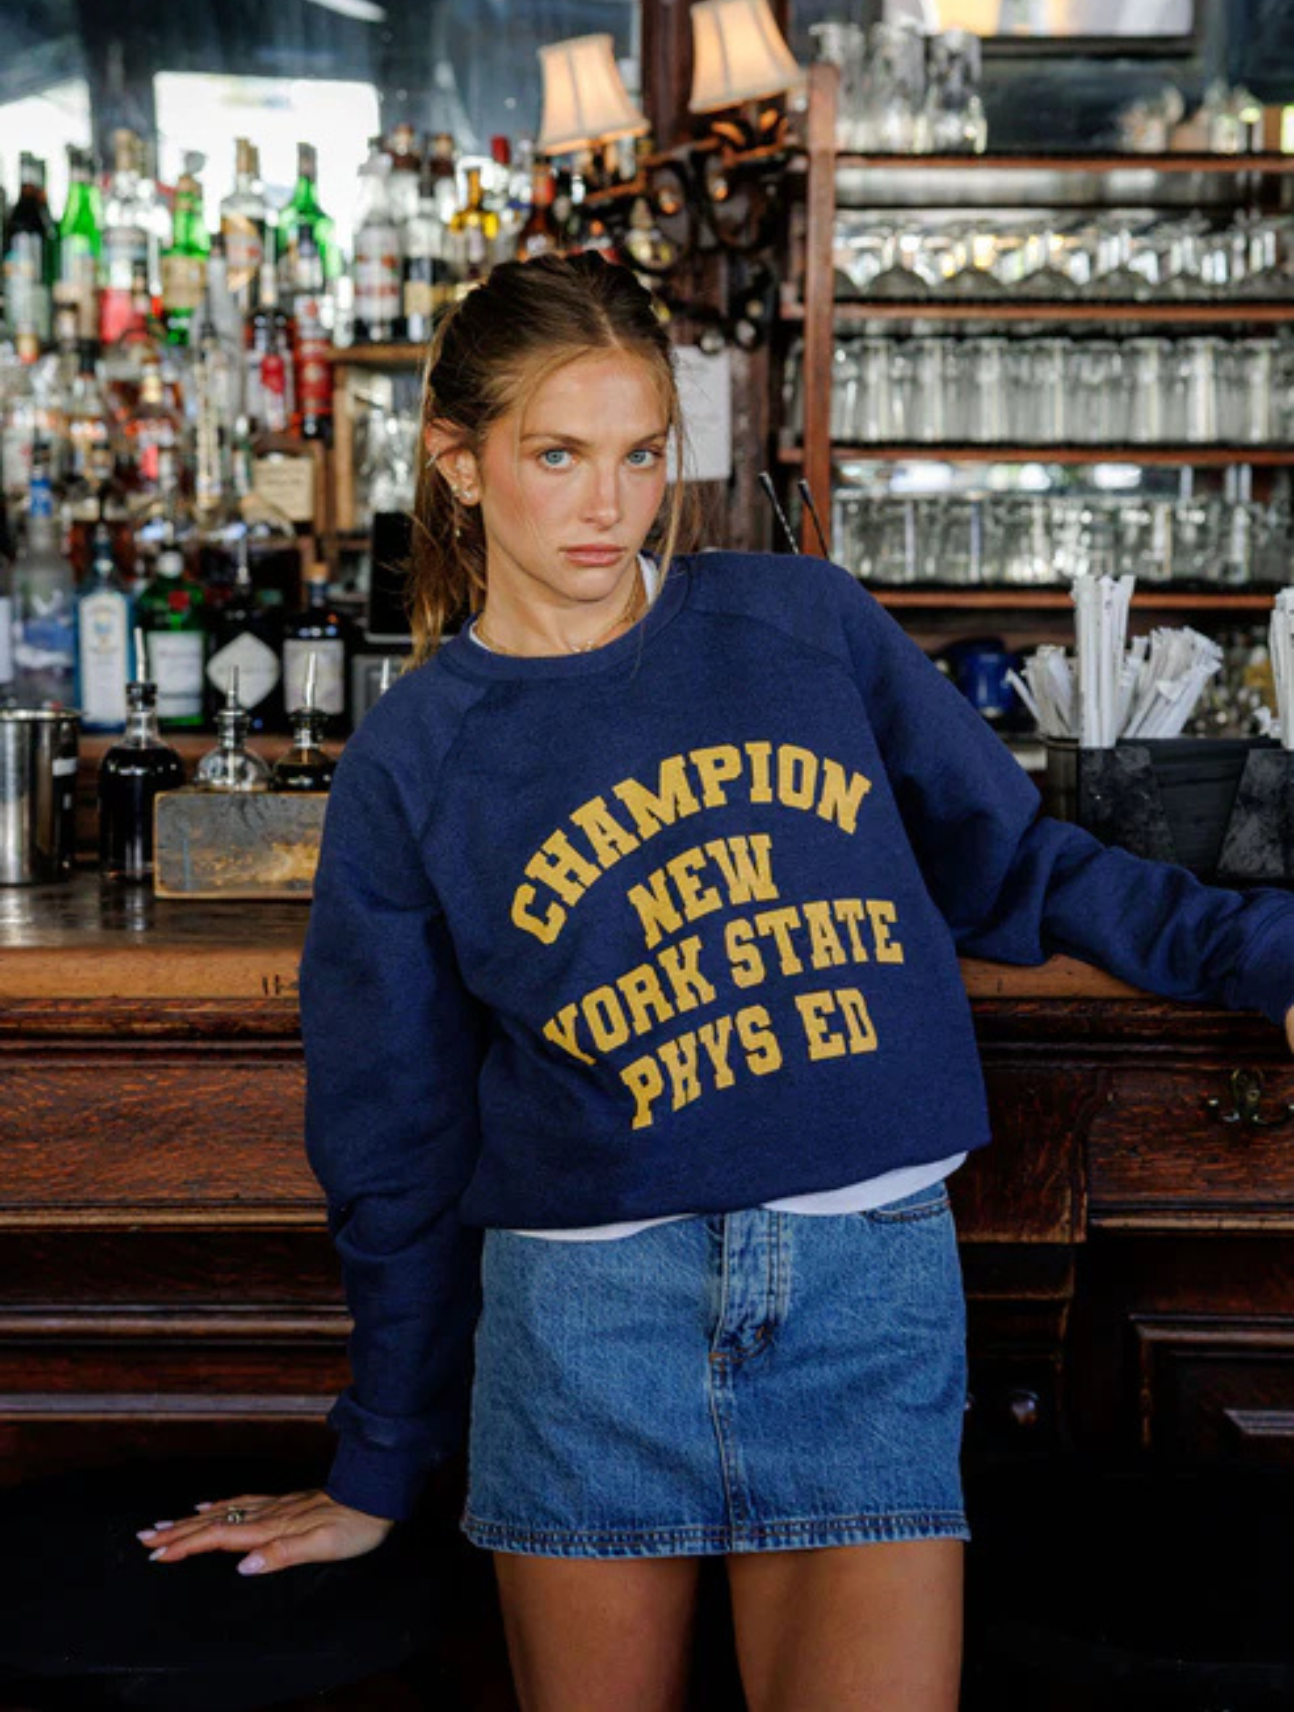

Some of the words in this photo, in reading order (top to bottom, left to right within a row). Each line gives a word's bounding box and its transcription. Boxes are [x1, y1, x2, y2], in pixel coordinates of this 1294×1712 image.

[511, 741, 872, 944] CHAMPION
[627, 834, 779, 949] NEW
[543, 935, 716, 1065] YORK
[724, 898, 904, 988] STATE
[619, 1005, 783, 1130] PHYS
[795, 988, 877, 1061] ED
